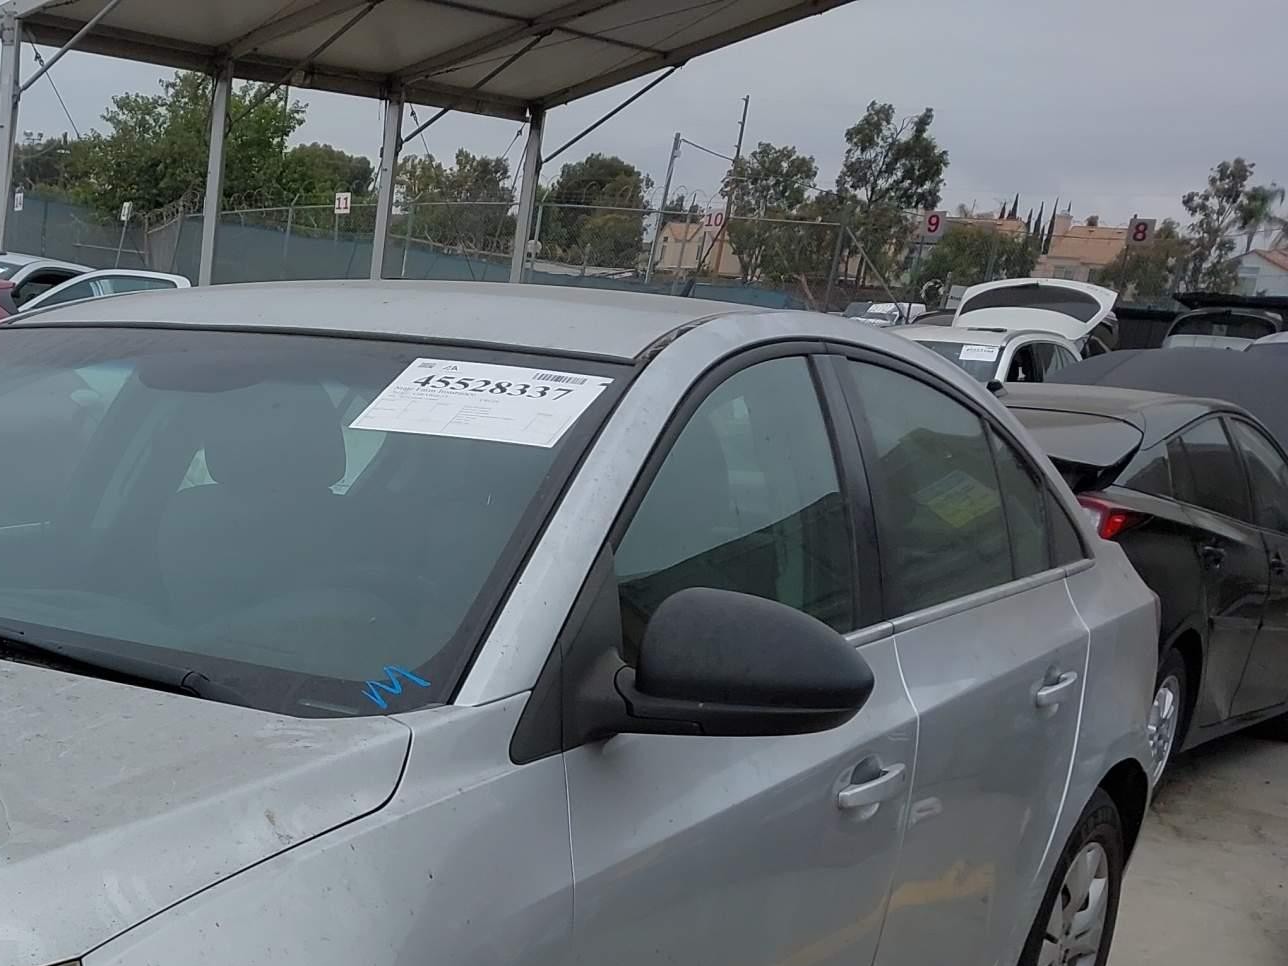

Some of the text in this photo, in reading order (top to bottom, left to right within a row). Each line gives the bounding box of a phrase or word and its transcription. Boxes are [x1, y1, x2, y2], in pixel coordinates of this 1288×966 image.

[335, 196, 349, 210] 11
[704, 212, 724, 227] 10
[927, 214, 940, 233] 9
[1132, 222, 1148, 242] 8
[413, 374, 574, 401] 45528337
